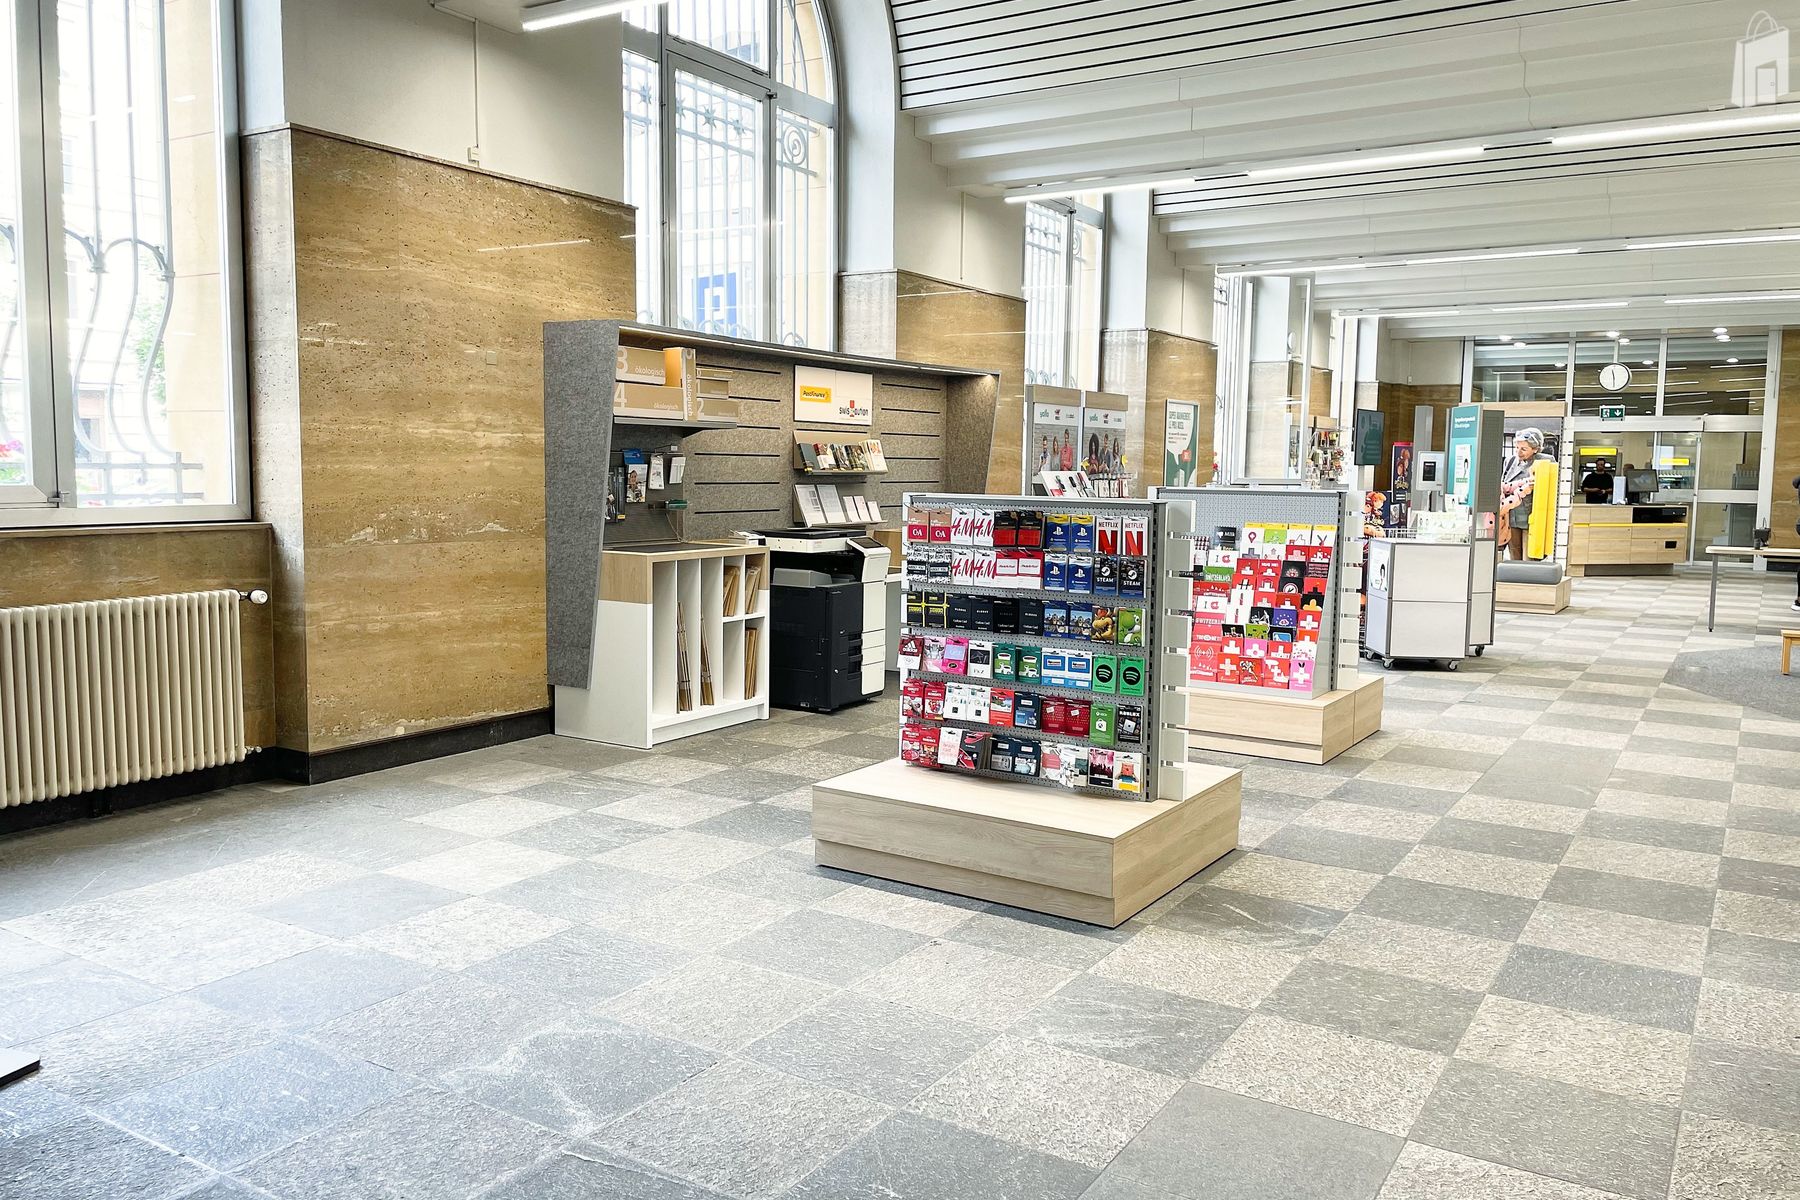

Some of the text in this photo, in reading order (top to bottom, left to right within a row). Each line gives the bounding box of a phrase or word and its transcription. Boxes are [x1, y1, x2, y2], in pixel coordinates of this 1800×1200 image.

[635, 367, 665, 377] ökologisch
[614, 382, 627, 408] 4
[653, 402, 679, 411] ökologisch
[951, 517, 974, 538] H&M
[1098, 521, 1118, 529] NETFLIX
[951, 558, 974, 578] H&M
[974, 559, 997, 580] H&M
